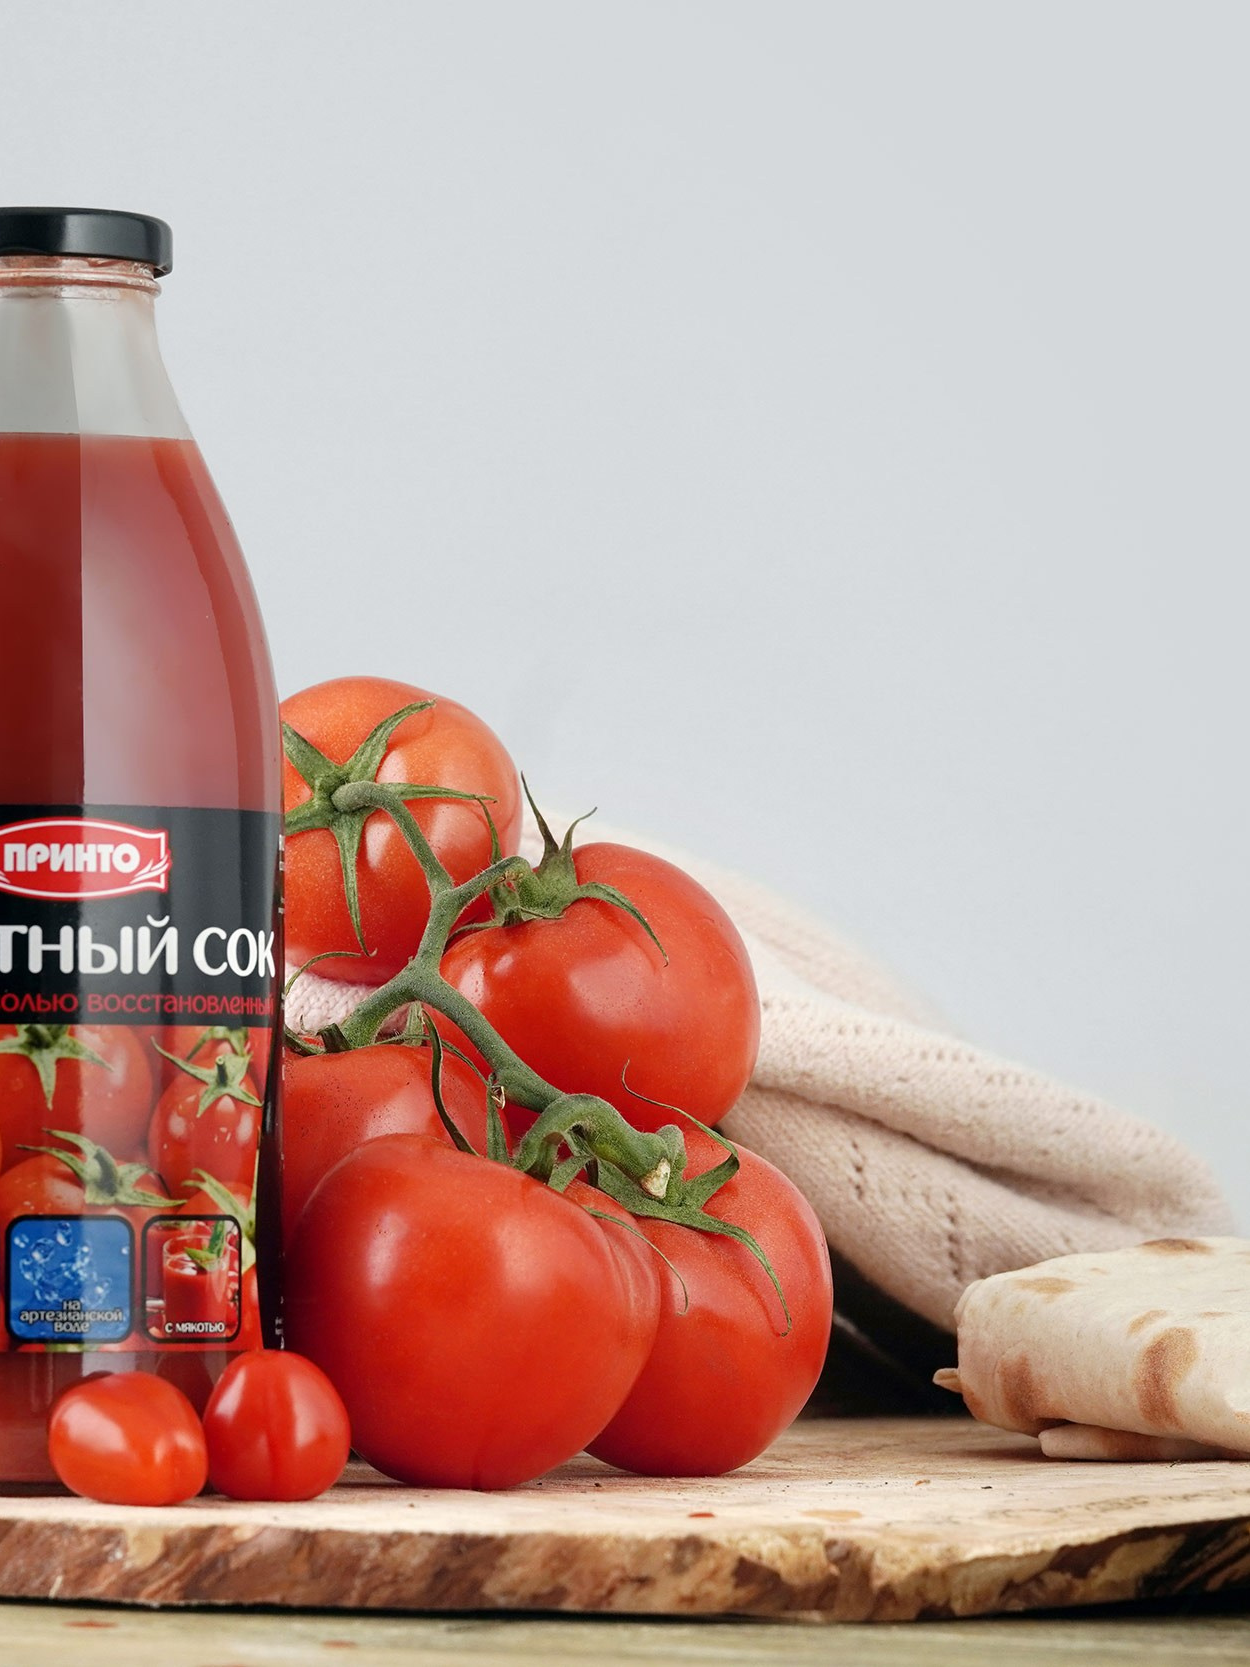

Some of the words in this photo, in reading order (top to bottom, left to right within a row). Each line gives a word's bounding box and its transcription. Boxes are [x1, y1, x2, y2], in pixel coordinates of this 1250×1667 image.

[3, 842, 140, 873] ПРИНТО
[192, 926, 276, 977] СОК
[87, 993, 274, 1016] восстановленный
[19, 1308, 124, 1325] артезианской
[62, 1300, 81, 1311] на
